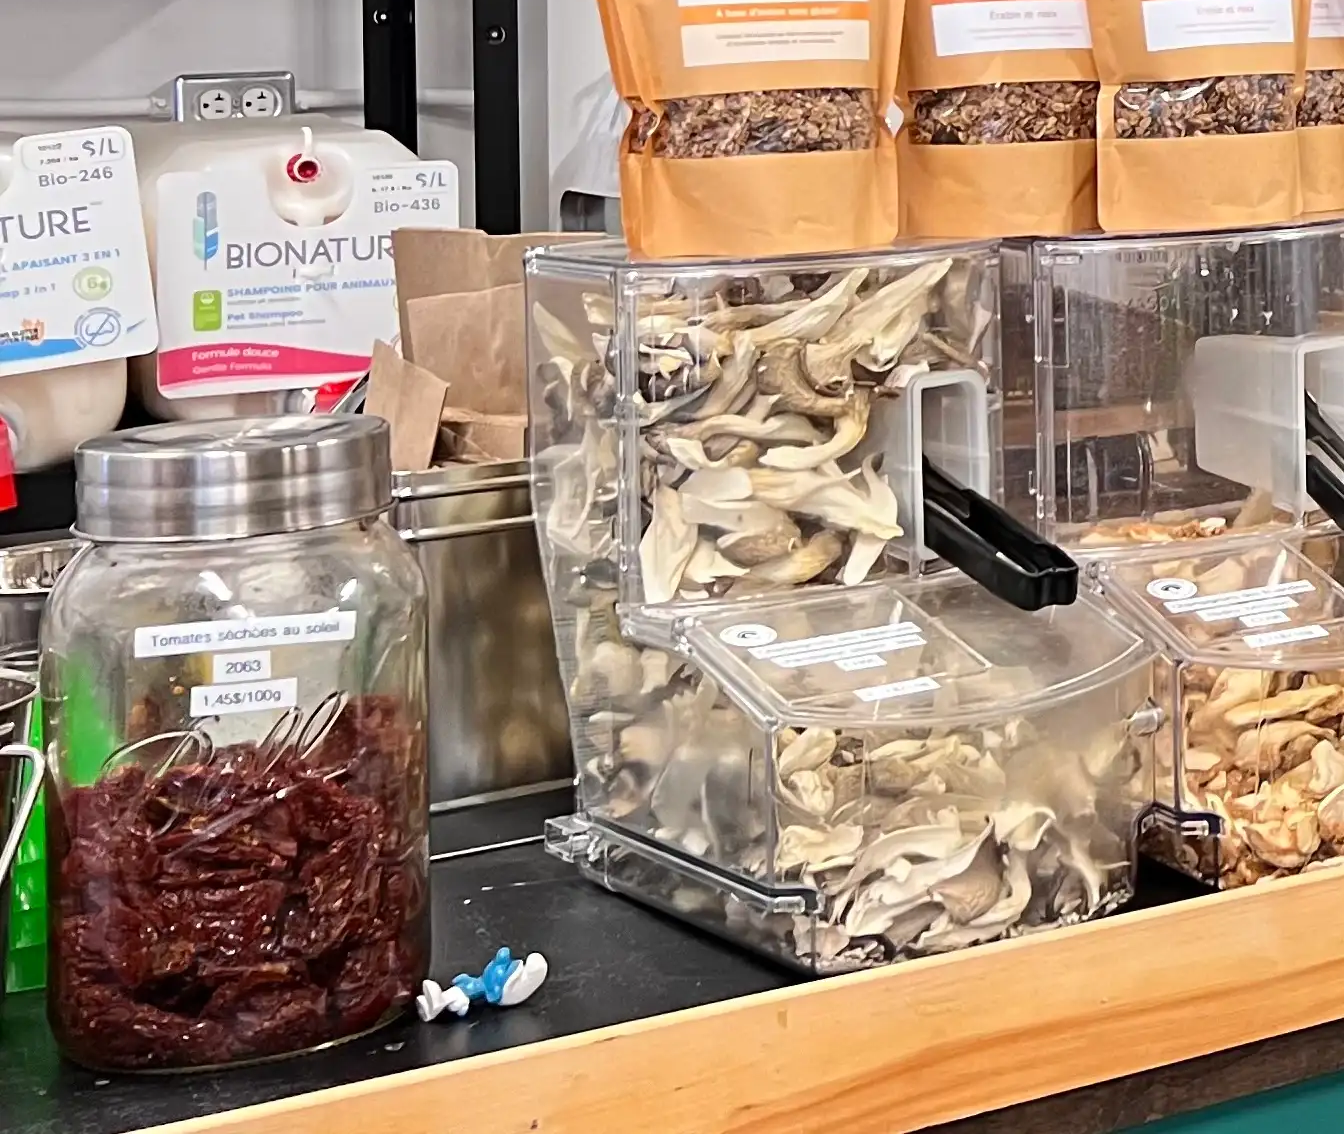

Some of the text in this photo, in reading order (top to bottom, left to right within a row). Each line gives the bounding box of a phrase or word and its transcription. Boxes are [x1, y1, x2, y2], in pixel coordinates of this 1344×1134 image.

[38, 165, 114, 188] Bio-246
[374, 198, 441, 214] Bio-436
[226, 234, 394, 271] BIONATUR
[152, 632, 212, 648] Tomates
[283, 626, 301, 636] au
[225, 659, 262, 675] 2063
